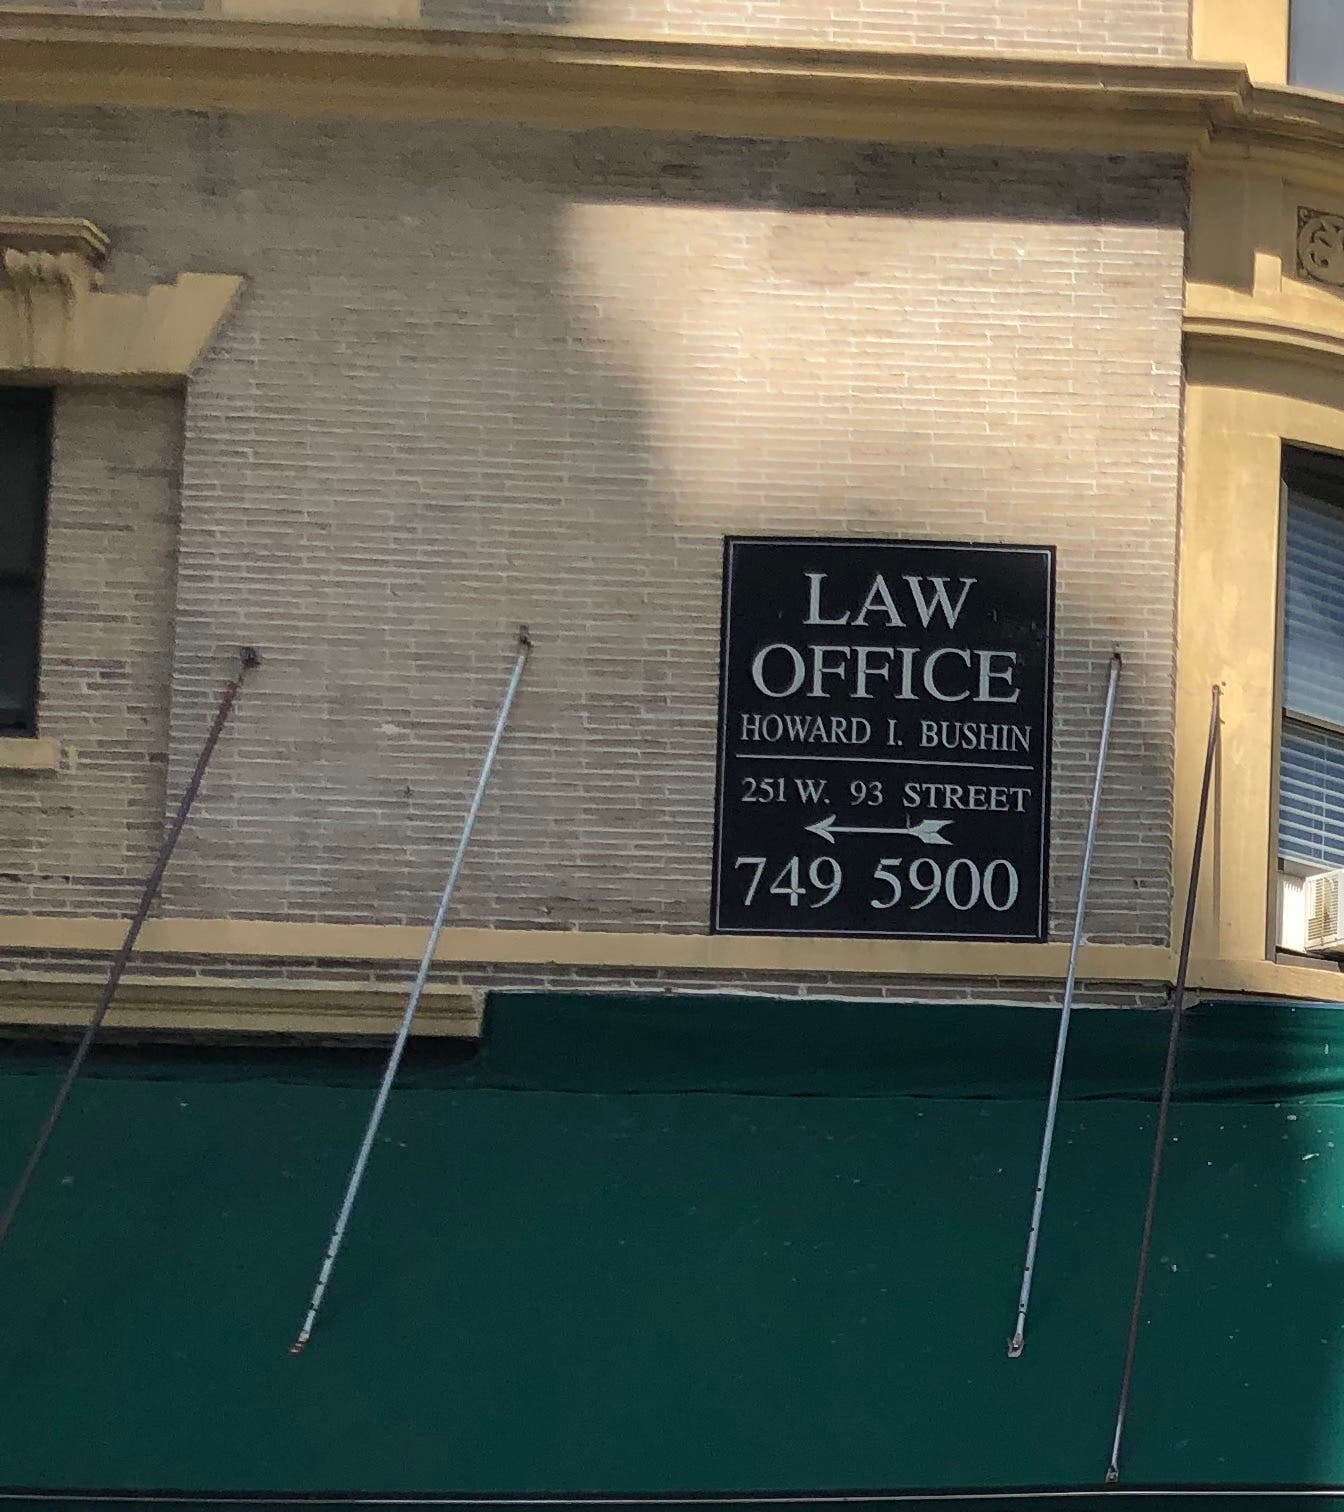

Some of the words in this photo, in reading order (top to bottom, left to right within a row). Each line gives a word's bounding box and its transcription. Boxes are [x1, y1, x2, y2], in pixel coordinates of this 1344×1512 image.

[802, 572, 978, 630] LAW
[751, 643, 1020, 704] OFFICE
[740, 713, 872, 745] HOWARD
[886, 718, 903, 747] I.
[919, 720, 1033, 753] BUSHIN
[741, 776, 786, 803] 251
[795, 778, 830, 806] W.
[850, 780, 884, 807] 93
[903, 783, 1032, 812] STREET
[735, 855, 843, 909] 749
[870, 857, 1019, 911] 5900
